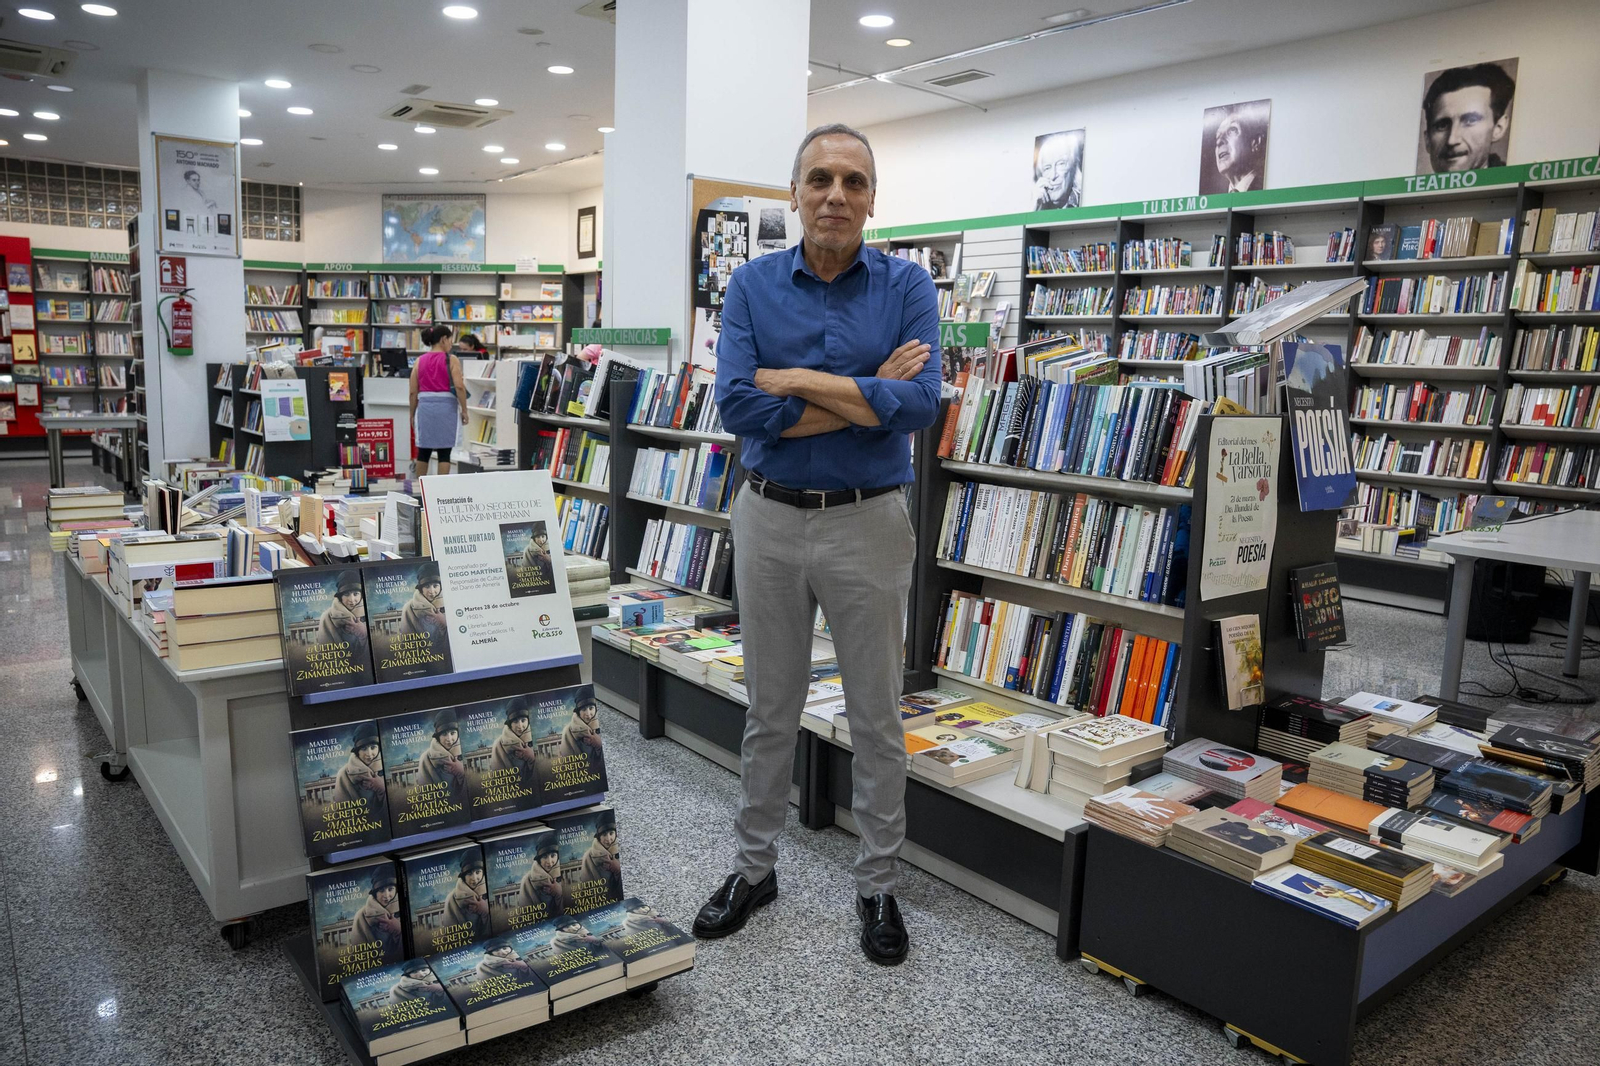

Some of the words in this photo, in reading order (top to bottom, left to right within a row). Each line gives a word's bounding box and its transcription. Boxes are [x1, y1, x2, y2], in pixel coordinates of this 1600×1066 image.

[1405, 171, 1478, 192] TEATRO
[1143, 196, 1208, 214] TURISMO
[441, 264, 482, 272] RESERVAS
[578, 330, 612, 344] ENSAYO
[614, 329, 658, 344] CIENCIAS
[938, 324, 967, 346] AS
[955, 430, 965, 452] VIRUS
[1109, 435, 1118, 458] PLANETA
[1114, 418, 1122, 435] AQUA
[1135, 437, 1145, 461] PLANETA
[1141, 420, 1149, 437] AQUA
[1218, 437, 1239, 446] Editorial
[1295, 396, 1351, 478] POESÍA
[1229, 452, 1240, 465] La
[1242, 447, 1264, 465] Bella
[1232, 462, 1271, 482] Varsovia
[437, 496, 464, 505] Presentación
[438, 505, 450, 515] EL
[487, 500, 529, 512] SECRETO
[530, 499, 542, 508] DE
[1234, 503, 1252, 512] Mundial
[439, 513, 474, 524] MATÍAS
[474, 510, 531, 522] ZIMMERMANN
[443, 534, 468, 545] MANUEL
[469, 532, 496, 543] HURTADO
[1062, 547, 1072, 571] Darwin
[1069, 507, 1080, 538] botánica
[1138, 519, 1147, 550] DOPAMINA
[444, 544, 477, 555] MARJALIZO
[1237, 540, 1266, 564] POESÍA
[687, 559, 697, 581] STEPHEN
[692, 535, 703, 559] HAWKING
[693, 561, 703, 583] STEPHEN
[699, 537, 709, 561] HAWKING
[471, 567, 503, 575] MARTÍNEZ
[294, 582, 321, 590] MANUEL
[450, 578, 479, 586] Responsable
[482, 580, 500, 588] Almería
[292, 589, 326, 597] HURTADO
[375, 587, 410, 595] MARJALIZO
[291, 595, 328, 604] MARJALIZO
[396, 632, 430, 642] ÚLTIMO
[487, 628, 507, 636] Católicos
[532, 629, 563, 639] Picasso
[1062, 620, 1072, 649] MUSTILL
[390, 642, 426, 652] SECRETO
[471, 637, 498, 645] ALMERÍA
[314, 642, 349, 653] ÚLTIMO
[306, 652, 346, 662] SECRETO
[394, 649, 430, 660] MATÍAS
[310, 660, 349, 671] MATÍAS
[381, 654, 444, 668] ZIMMERMANN
[296, 665, 364, 681] ZIMMERMANN
[537, 705, 566, 714] HURTADO
[539, 700, 563, 708] MANUEL
[468, 711, 494, 720] MANUEL
[466, 723, 499, 733] MARJALIZO
[467, 717, 497, 727] HURTADO
[392, 730, 424, 739] HURTADO
[394, 724, 421, 733] MANUEL
[309, 738, 338, 748] MANUEL
[391, 736, 427, 746] MARJALIZO
[307, 744, 342, 755] HURTADO
[306, 751, 345, 762] MARJALIZO
[551, 762, 584, 775] SECRETO
[556, 769, 588, 782] MATÍAS
[412, 781, 448, 794] ÚLTIMO
[481, 776, 516, 788] SECRETO
[544, 773, 600, 791] ZIMMERMANN
[485, 783, 520, 797] MATÍAS
[407, 790, 444, 804] SECRETO
[473, 788, 533, 807] ZIMMERMANN
[328, 798, 367, 811] ÚLTIMO
[411, 799, 449, 812] MATÍAS
[322, 808, 364, 822] SECRETO
[398, 803, 462, 823] ZIMMERMANN
[327, 816, 367, 831] MATÍAS
[561, 825, 585, 833] MANUEL
[313, 821, 382, 842] ZIMMERMANN
[560, 831, 587, 840] HURTADO
[498, 847, 523, 856] MANUEL
[496, 853, 526, 863] HURTADO
[420, 864, 447, 874] MANUEL
[419, 870, 450, 882] HURTADO
[328, 880, 357, 891] MANUEL
[326, 886, 360, 898] HURTADO
[571, 887, 604, 899] SECRETO
[508, 911, 544, 926] SECRETO
[432, 931, 469, 946] SECRETO
[338, 950, 379, 966] SECRETO
[342, 959, 382, 974] MATÍAS
[466, 982, 534, 1006] ZIMMERMANN
[372, 1006, 447, 1031] ZIMMERMANN
